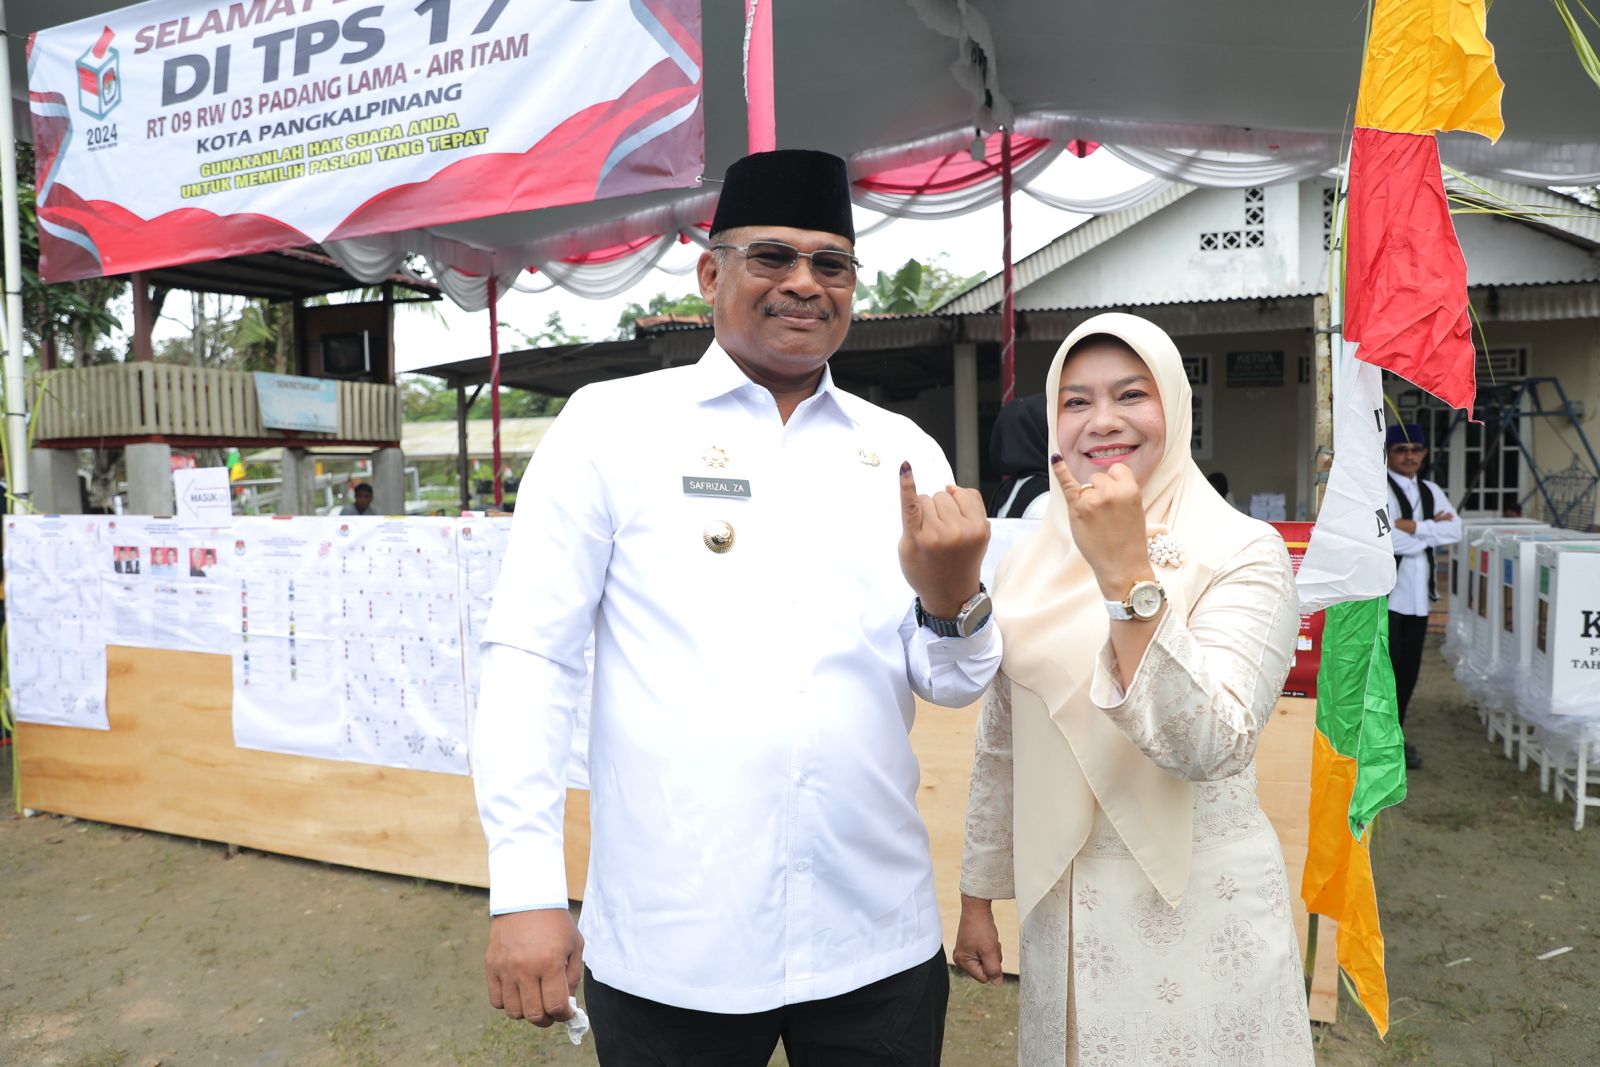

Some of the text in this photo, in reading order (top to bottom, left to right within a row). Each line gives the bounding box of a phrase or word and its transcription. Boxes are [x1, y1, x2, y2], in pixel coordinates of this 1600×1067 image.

[146, 115, 167, 139] RT
[171, 110, 191, 134] 09
[197, 102, 227, 128] RW
[231, 97, 253, 121] 03
[258, 76, 341, 115] PADANG
[347, 62, 408, 95] LAMA
[426, 49, 464, 78] AIR
[470, 33, 529, 68] ITAM
[161, 44, 231, 107] DI
[253, 5, 385, 84] TPS
[86, 123, 117, 146] 2024
[197, 83, 462, 154] KOTA PANGKALPINANG
[200, 112, 459, 178] GUNAKANLAH HAK SUARA ANDA
[181, 127, 489, 199] UNTUK MEMILIH PASLON YANG TEPAT
[190, 492, 218, 503] MASUK
[689, 481, 744, 493] SAFRIZAL ZA
